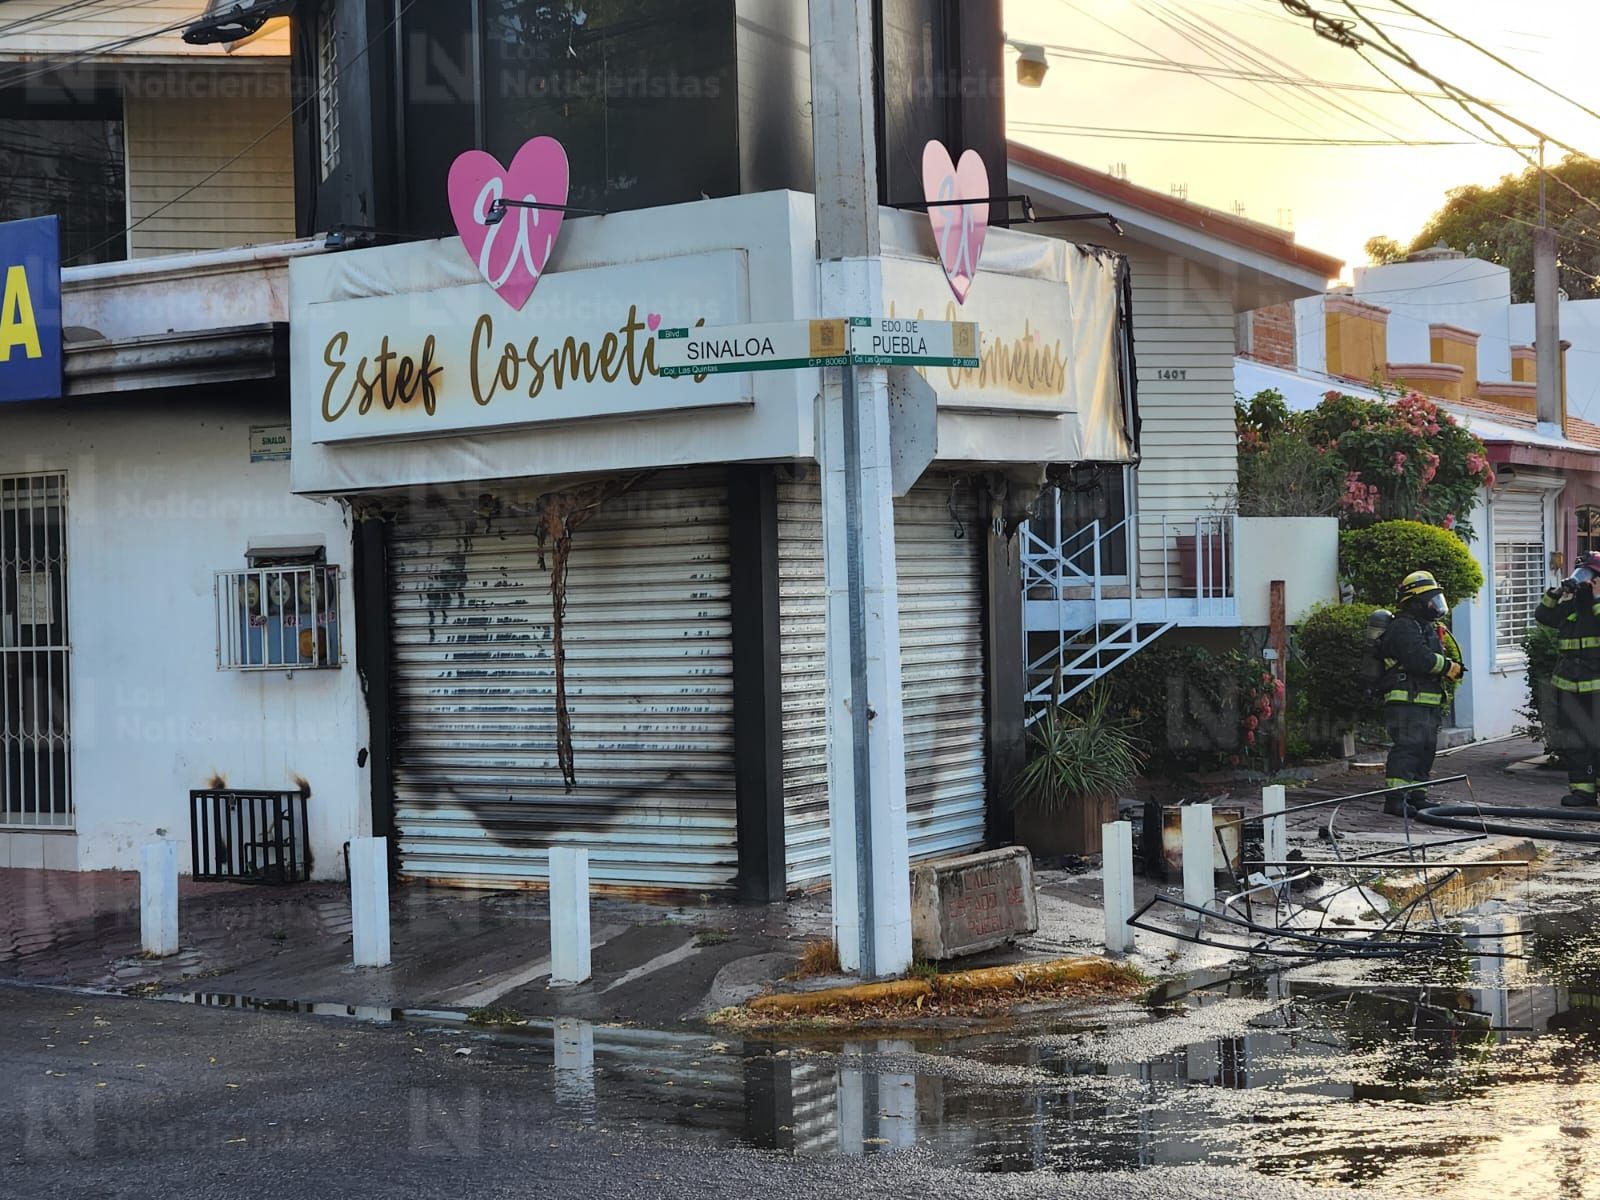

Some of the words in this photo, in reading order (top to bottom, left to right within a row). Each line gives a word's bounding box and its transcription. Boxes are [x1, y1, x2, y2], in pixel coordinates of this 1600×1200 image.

[905, 321, 919, 333] DE
[687, 337, 775, 360] SINALOA
[872, 335, 928, 355] PUEBLA
[321, 331, 444, 422] Estef
[470, 304, 706, 408] Cosmeti
[678, 366, 691, 375] Las
[692, 364, 718, 373] Quintas
[825, 357, 847, 366] 80060
